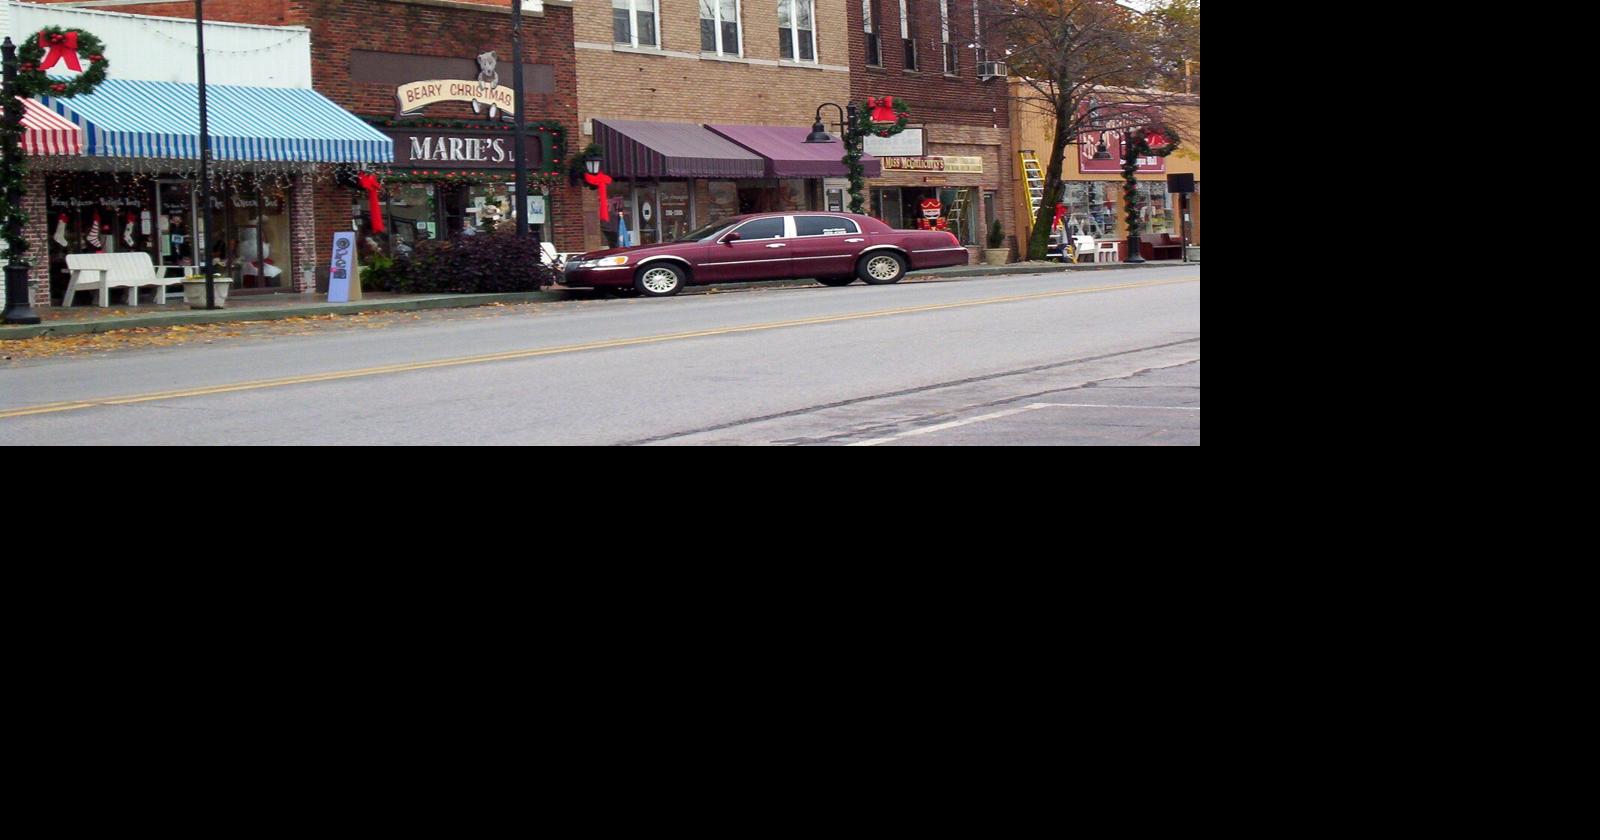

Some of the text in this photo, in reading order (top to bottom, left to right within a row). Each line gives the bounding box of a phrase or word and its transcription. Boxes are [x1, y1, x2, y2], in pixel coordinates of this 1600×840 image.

[406, 83, 513, 106] BEARY CHRISTMAS
[409, 136, 505, 162] MARIE'S
